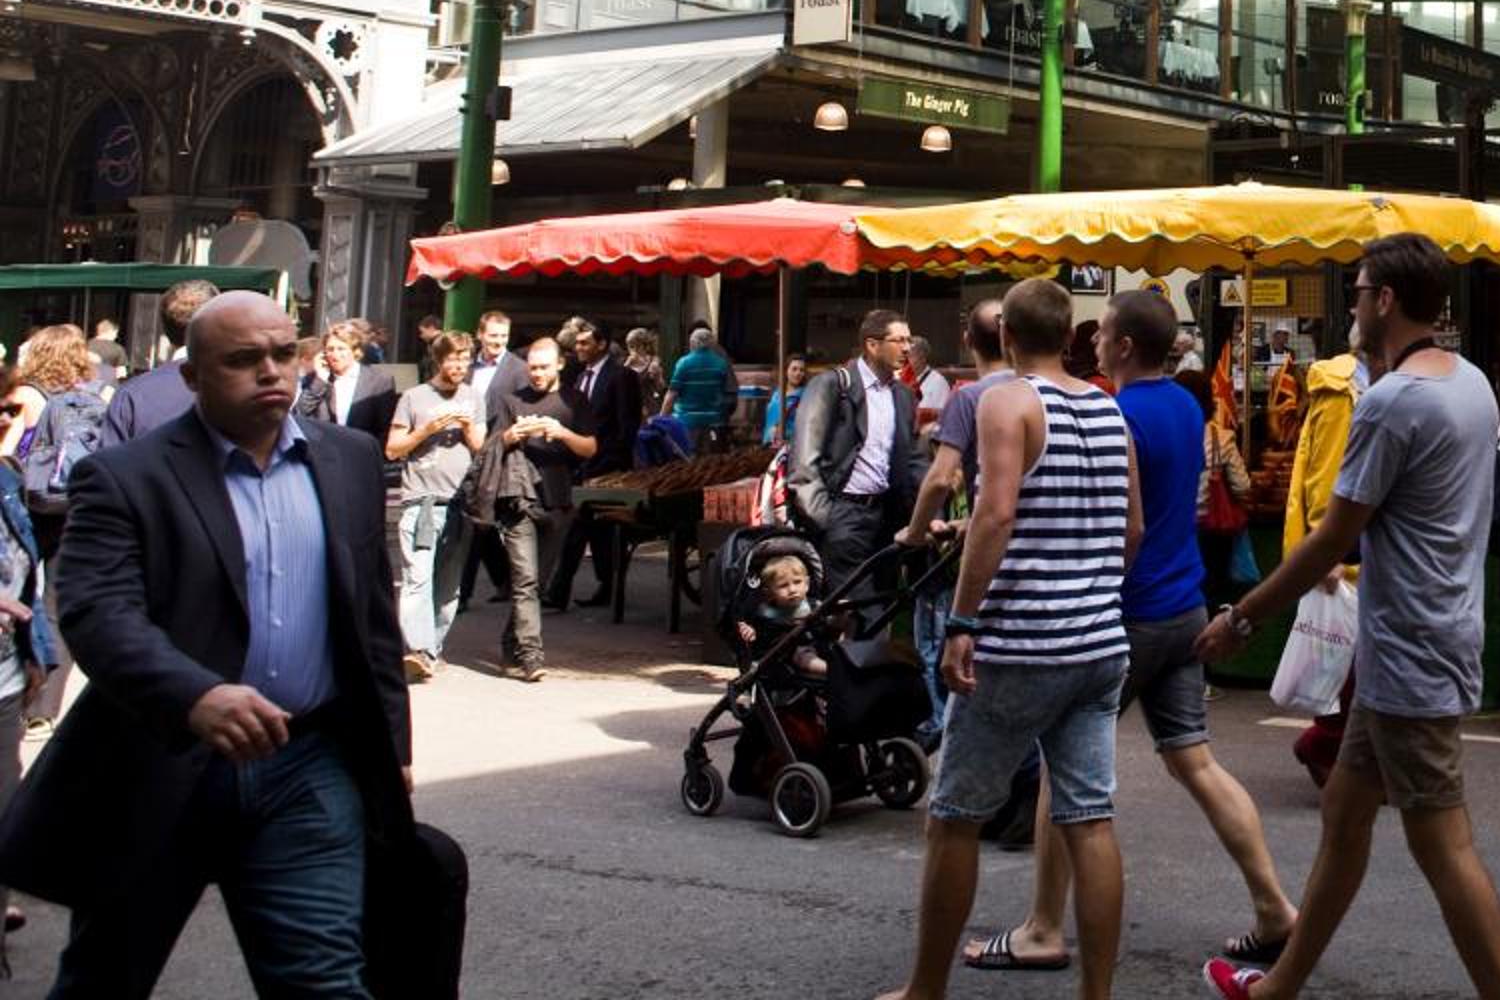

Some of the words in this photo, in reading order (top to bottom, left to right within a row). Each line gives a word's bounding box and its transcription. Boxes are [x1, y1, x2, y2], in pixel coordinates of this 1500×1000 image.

[1004, 24, 1042, 49] roast
[905, 90, 923, 108] The
[923, 94, 953, 114] Ginger
[953, 99, 970, 118] Pig
